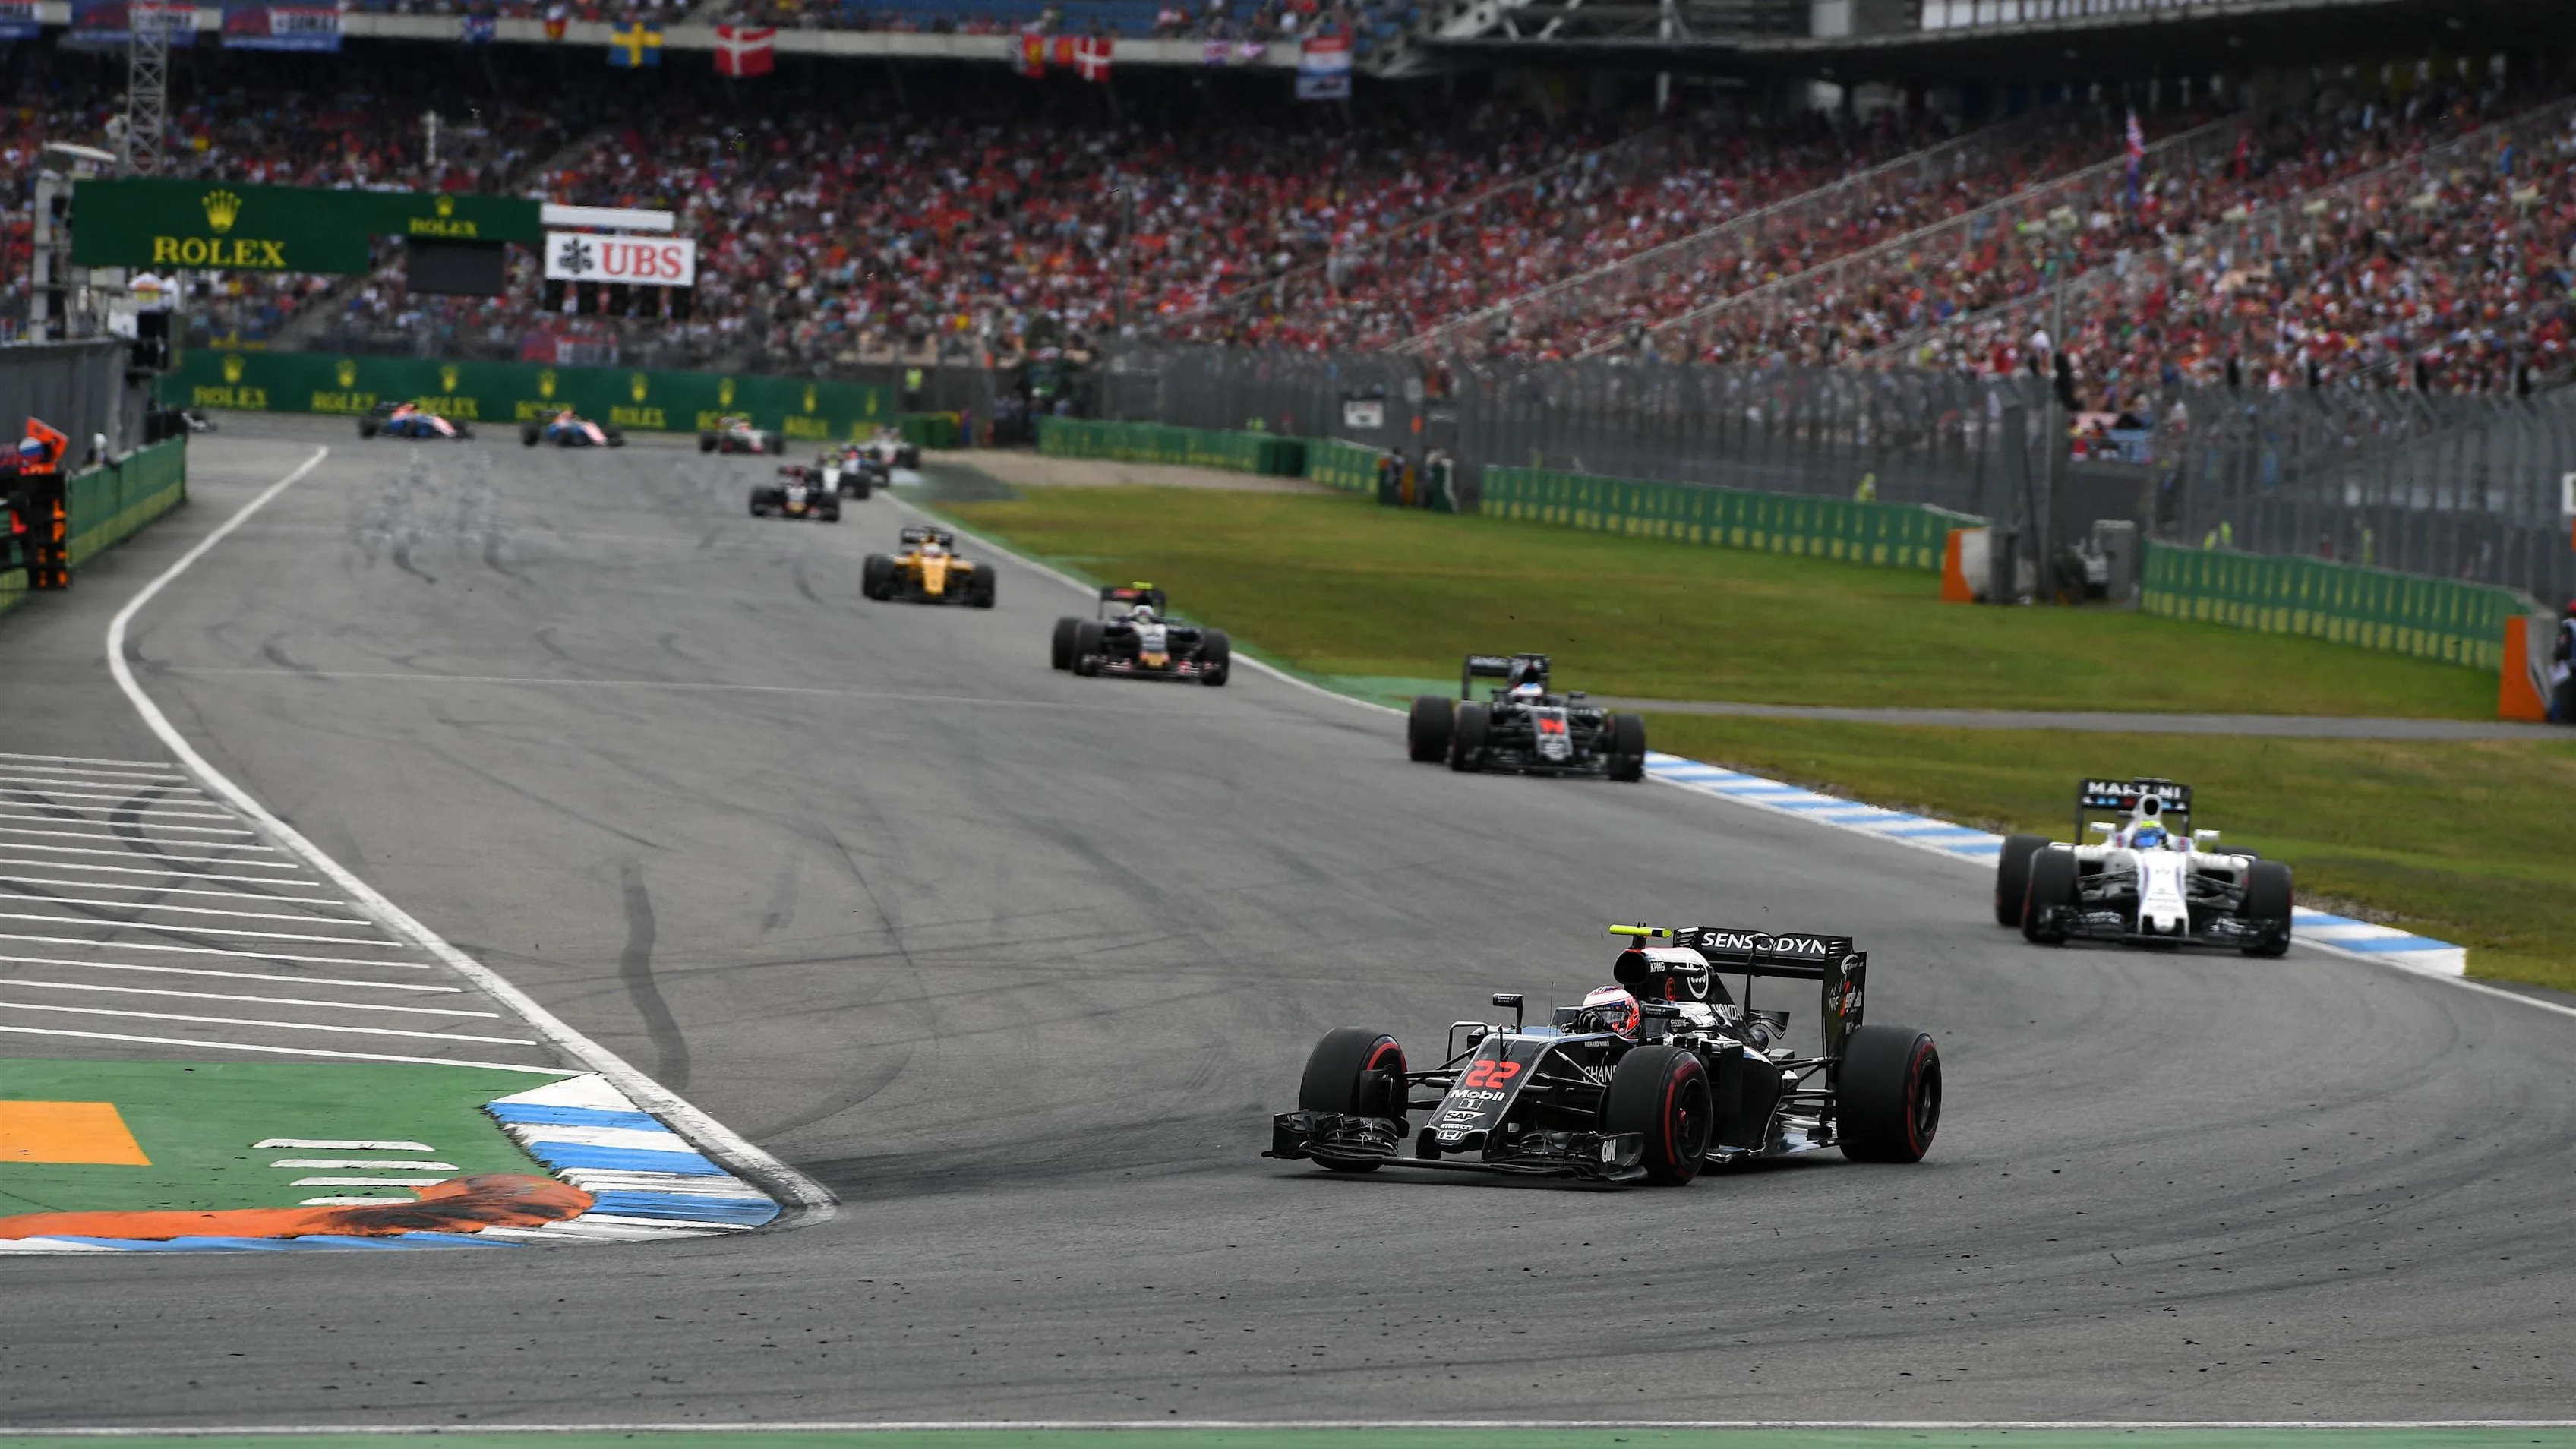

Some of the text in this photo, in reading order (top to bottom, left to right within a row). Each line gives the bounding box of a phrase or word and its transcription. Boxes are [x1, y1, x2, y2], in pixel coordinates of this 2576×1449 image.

[409, 217, 478, 237] ROLEX
[153, 236, 286, 267] ROLEX
[601, 242, 682, 279] UBS
[1650, 962, 1665, 973] KPMG
[1466, 1059, 1520, 1088] 22
[1449, 1090, 1506, 1101] Mobil
[1602, 1139, 1617, 1163] CNN
